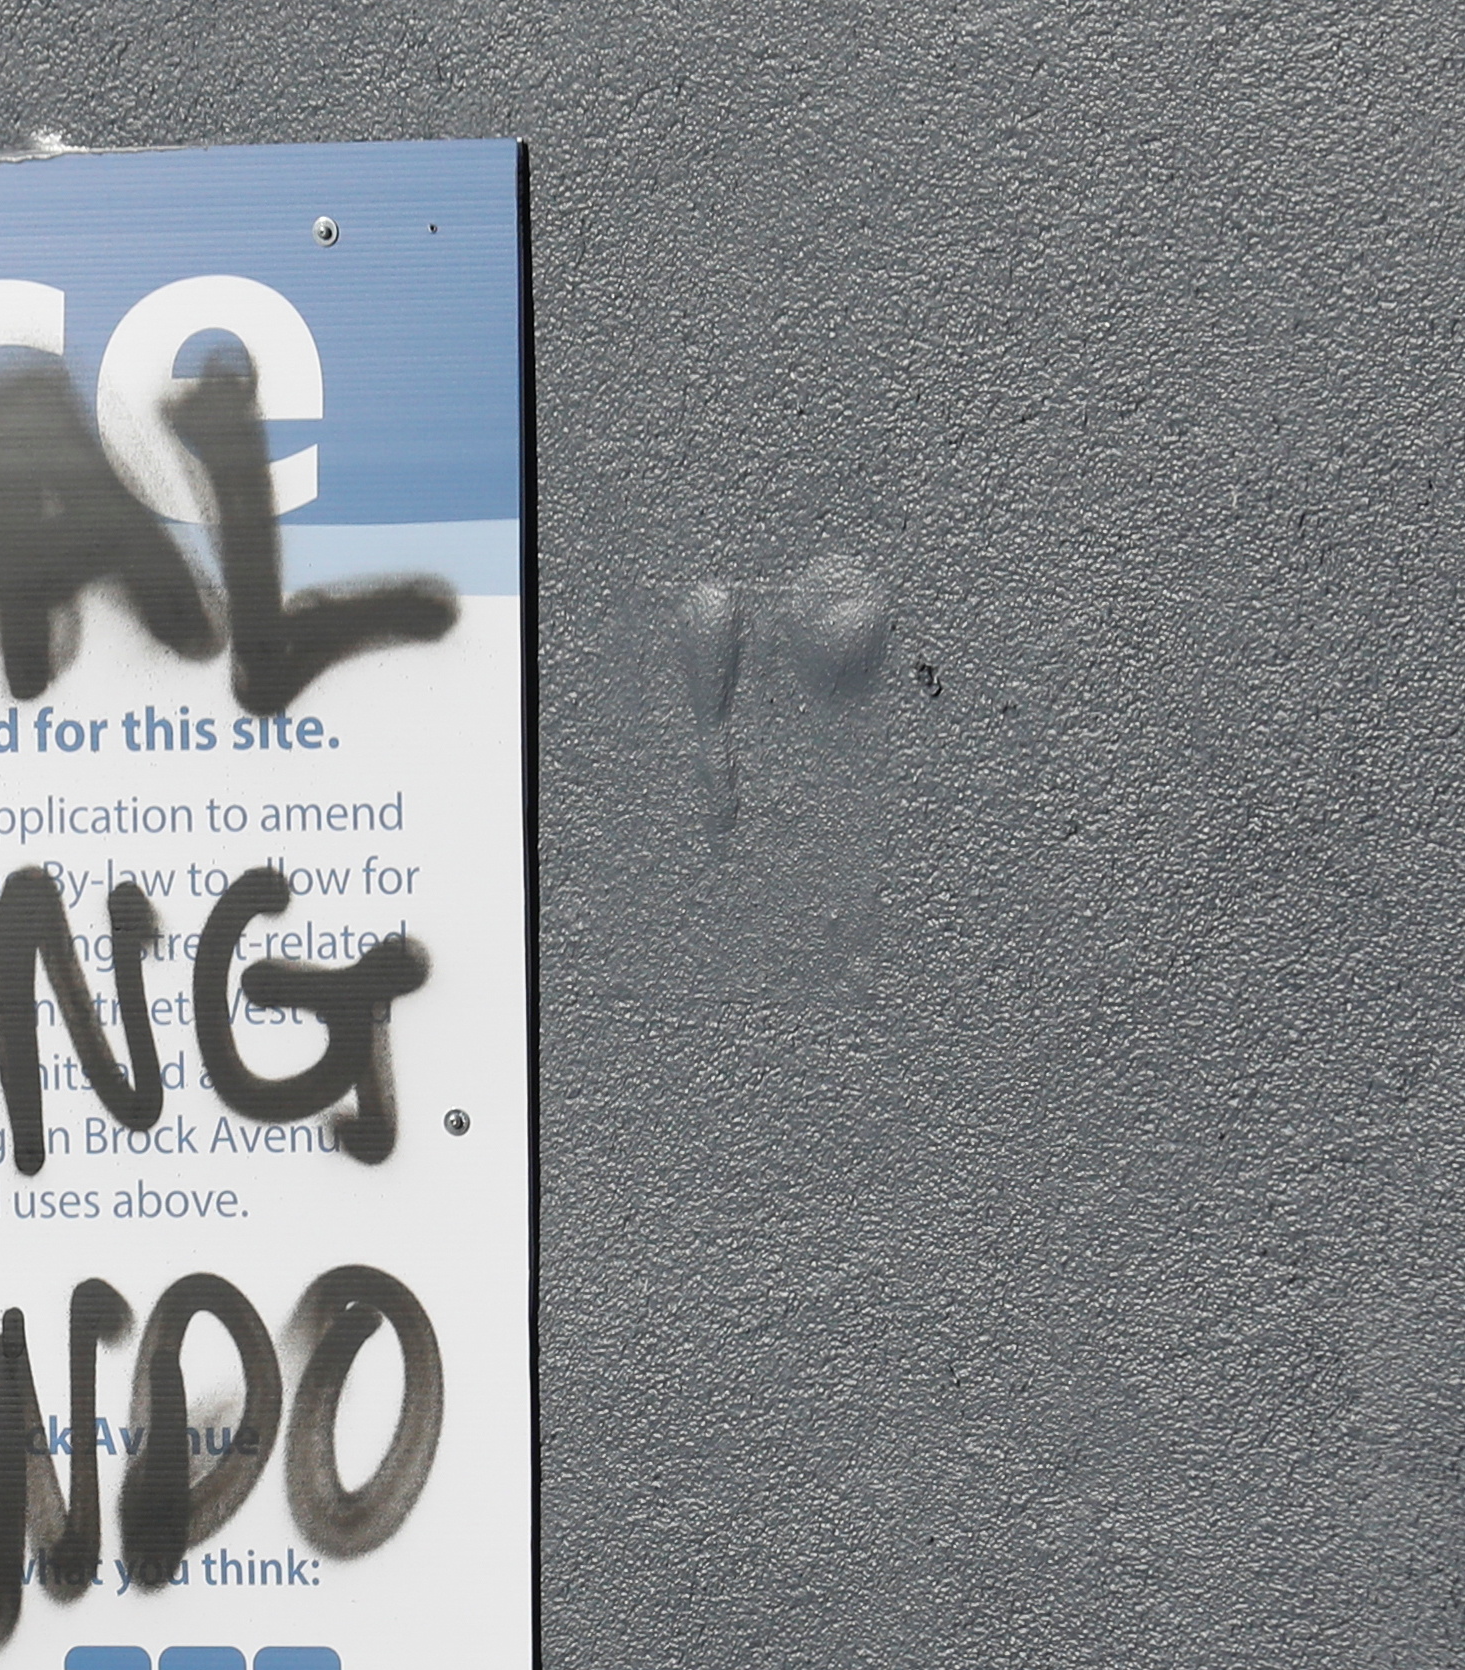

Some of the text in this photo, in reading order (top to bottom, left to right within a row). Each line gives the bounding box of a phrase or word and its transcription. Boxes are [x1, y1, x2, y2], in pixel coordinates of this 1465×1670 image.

[33, 706, 109, 753] for
[121, 705, 218, 752] this
[233, 712, 340, 751] site.
[205, 798, 248, 834] to
[260, 791, 404, 832] amend
[361, 855, 421, 895] for
[85, 1114, 198, 1155] Brock
[209, 1115, 358, 1154] Avenu
[13, 1189, 100, 1219] uses
[113, 1179, 249, 1219] above.
[201, 1548, 321, 1586] think:
